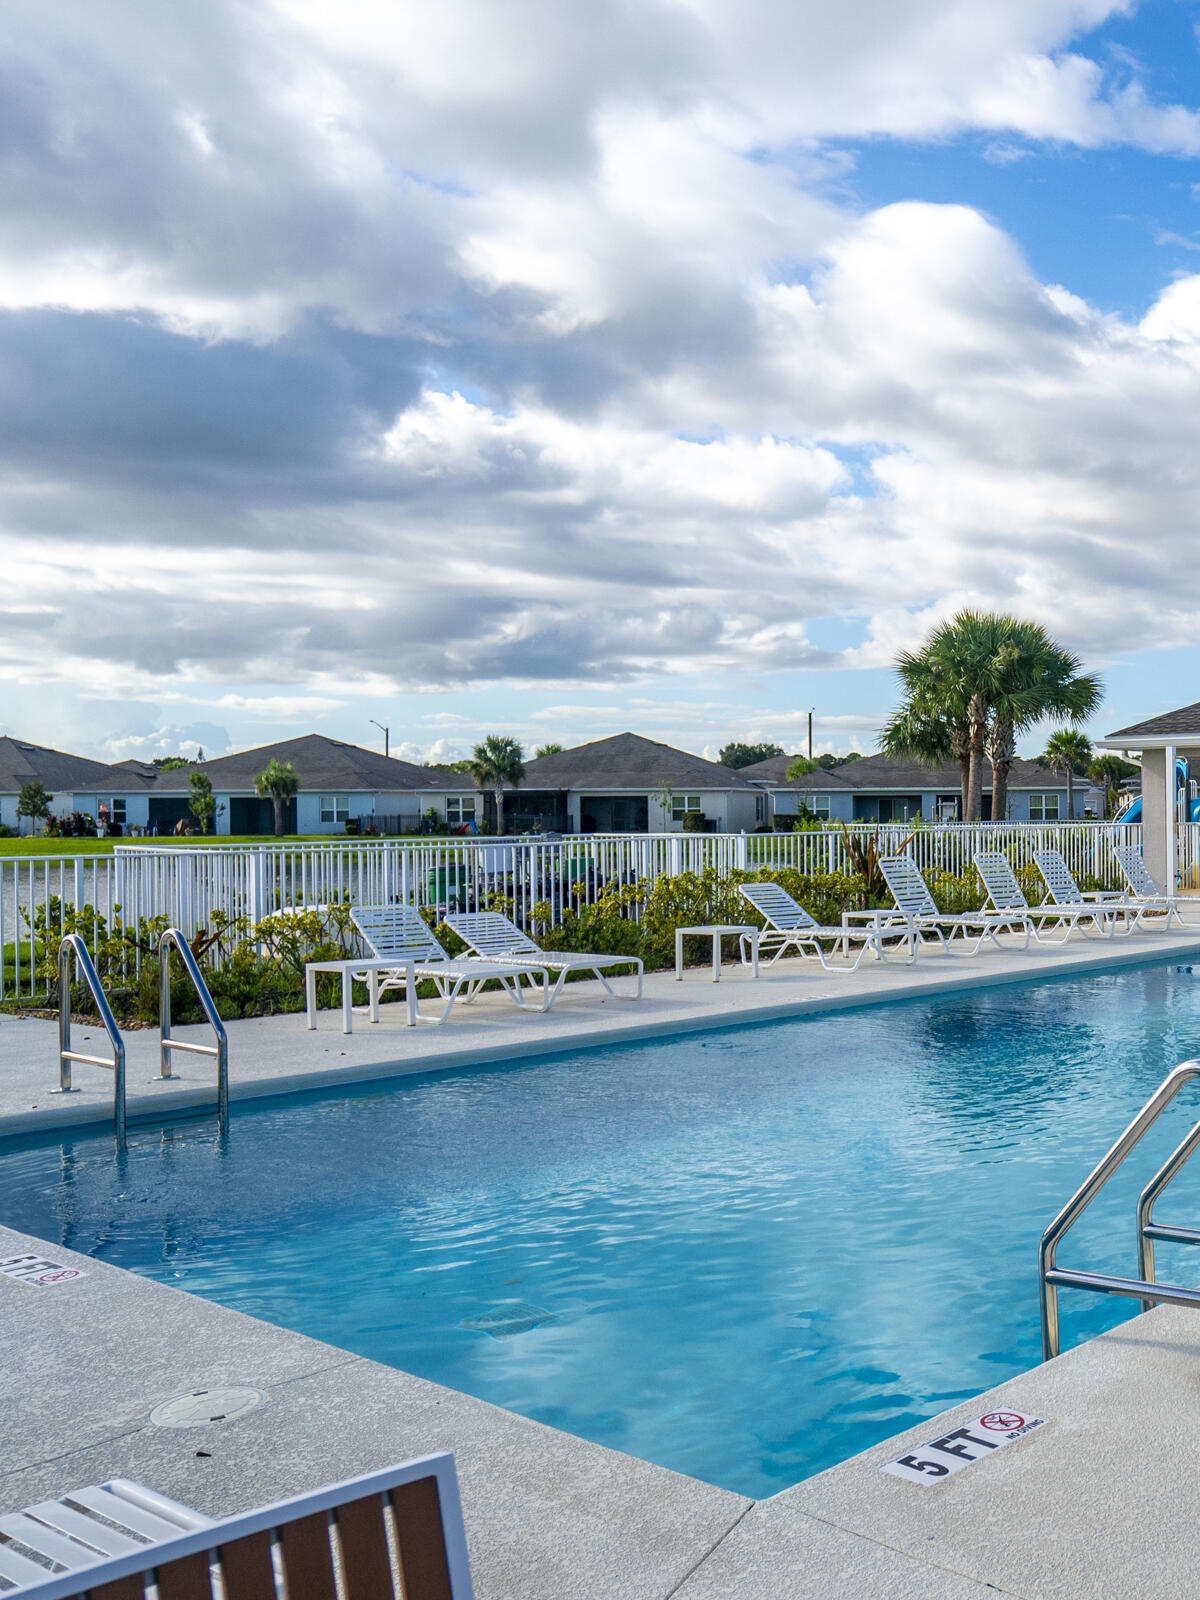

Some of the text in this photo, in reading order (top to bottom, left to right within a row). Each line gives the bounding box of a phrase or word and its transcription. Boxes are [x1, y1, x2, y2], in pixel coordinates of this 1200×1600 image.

[4, 1261, 63, 1277] FT
[1005, 1419, 1044, 1440] NO DIVING
[897, 1428, 1000, 1476] 5 FT
